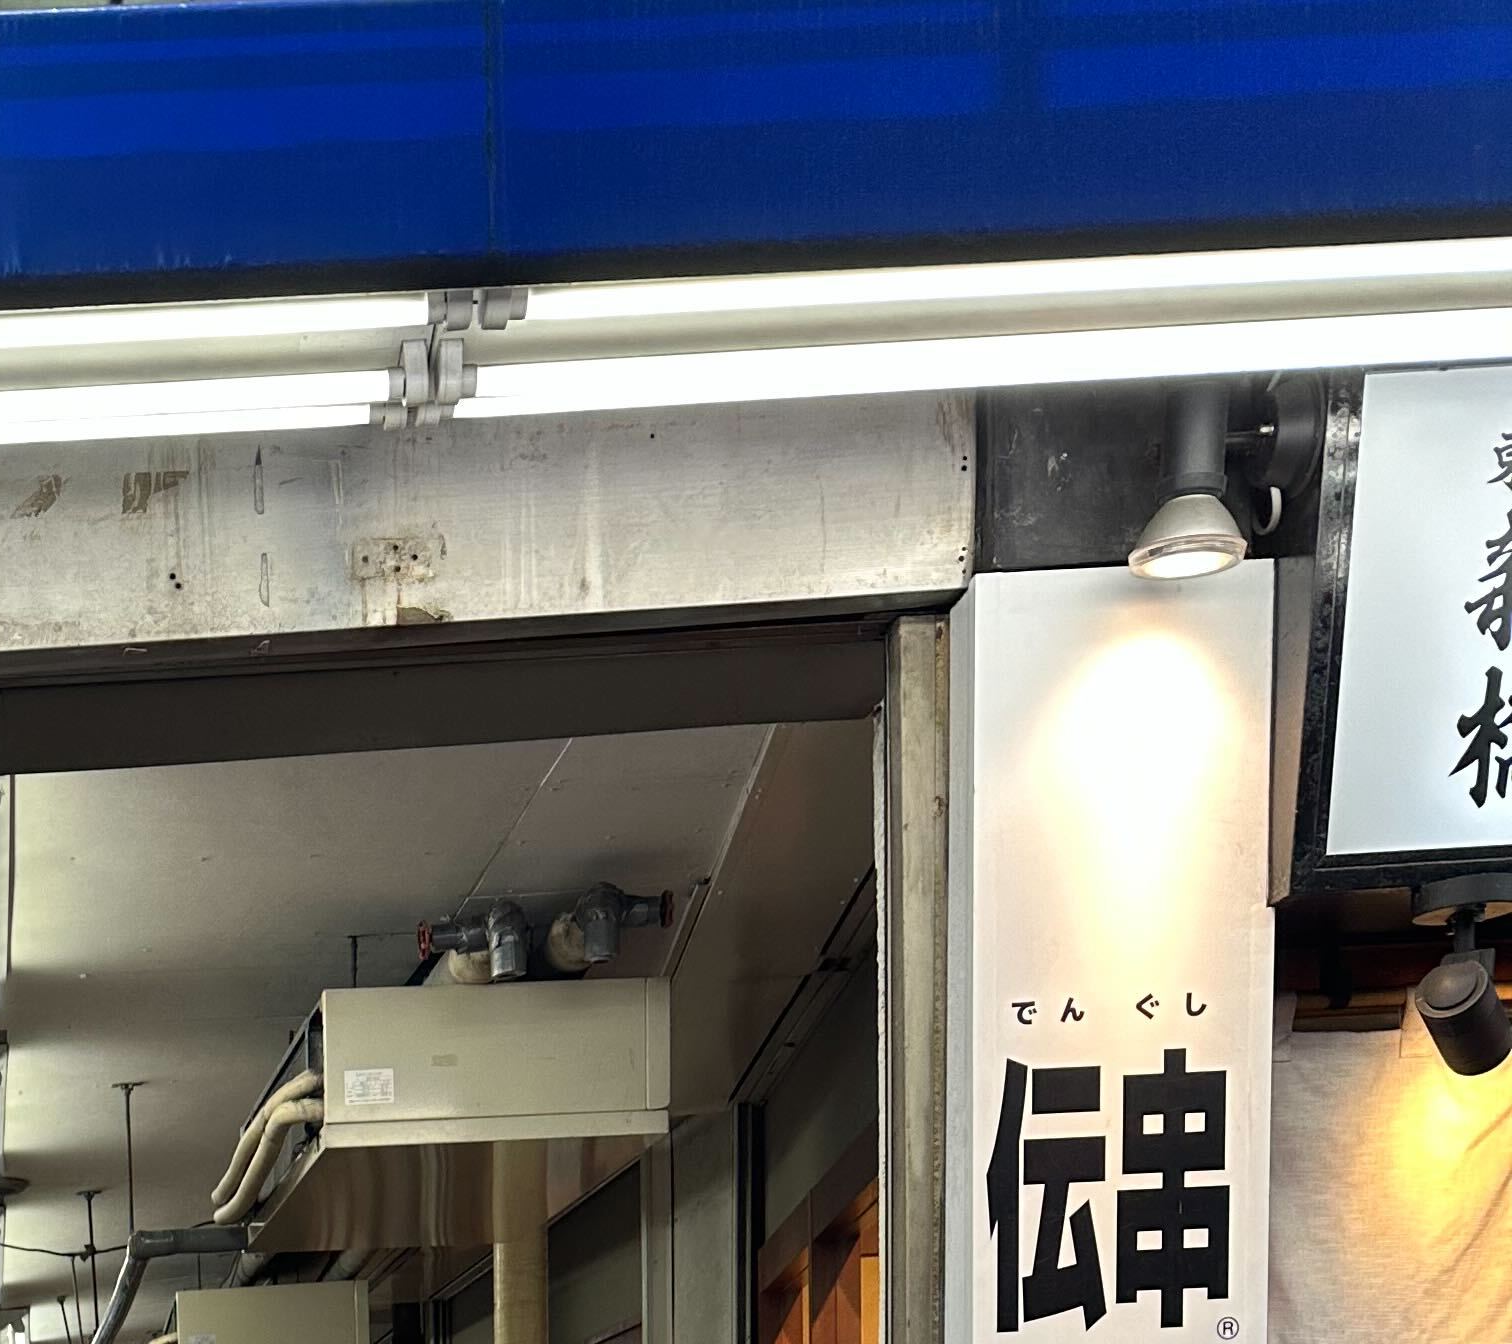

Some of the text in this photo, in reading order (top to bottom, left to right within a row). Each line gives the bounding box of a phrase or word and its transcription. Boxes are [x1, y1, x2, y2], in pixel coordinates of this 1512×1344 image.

[1012, 993, 1207, 1025] でんぐし
[986, 1048, 1231, 1333] 伝串
